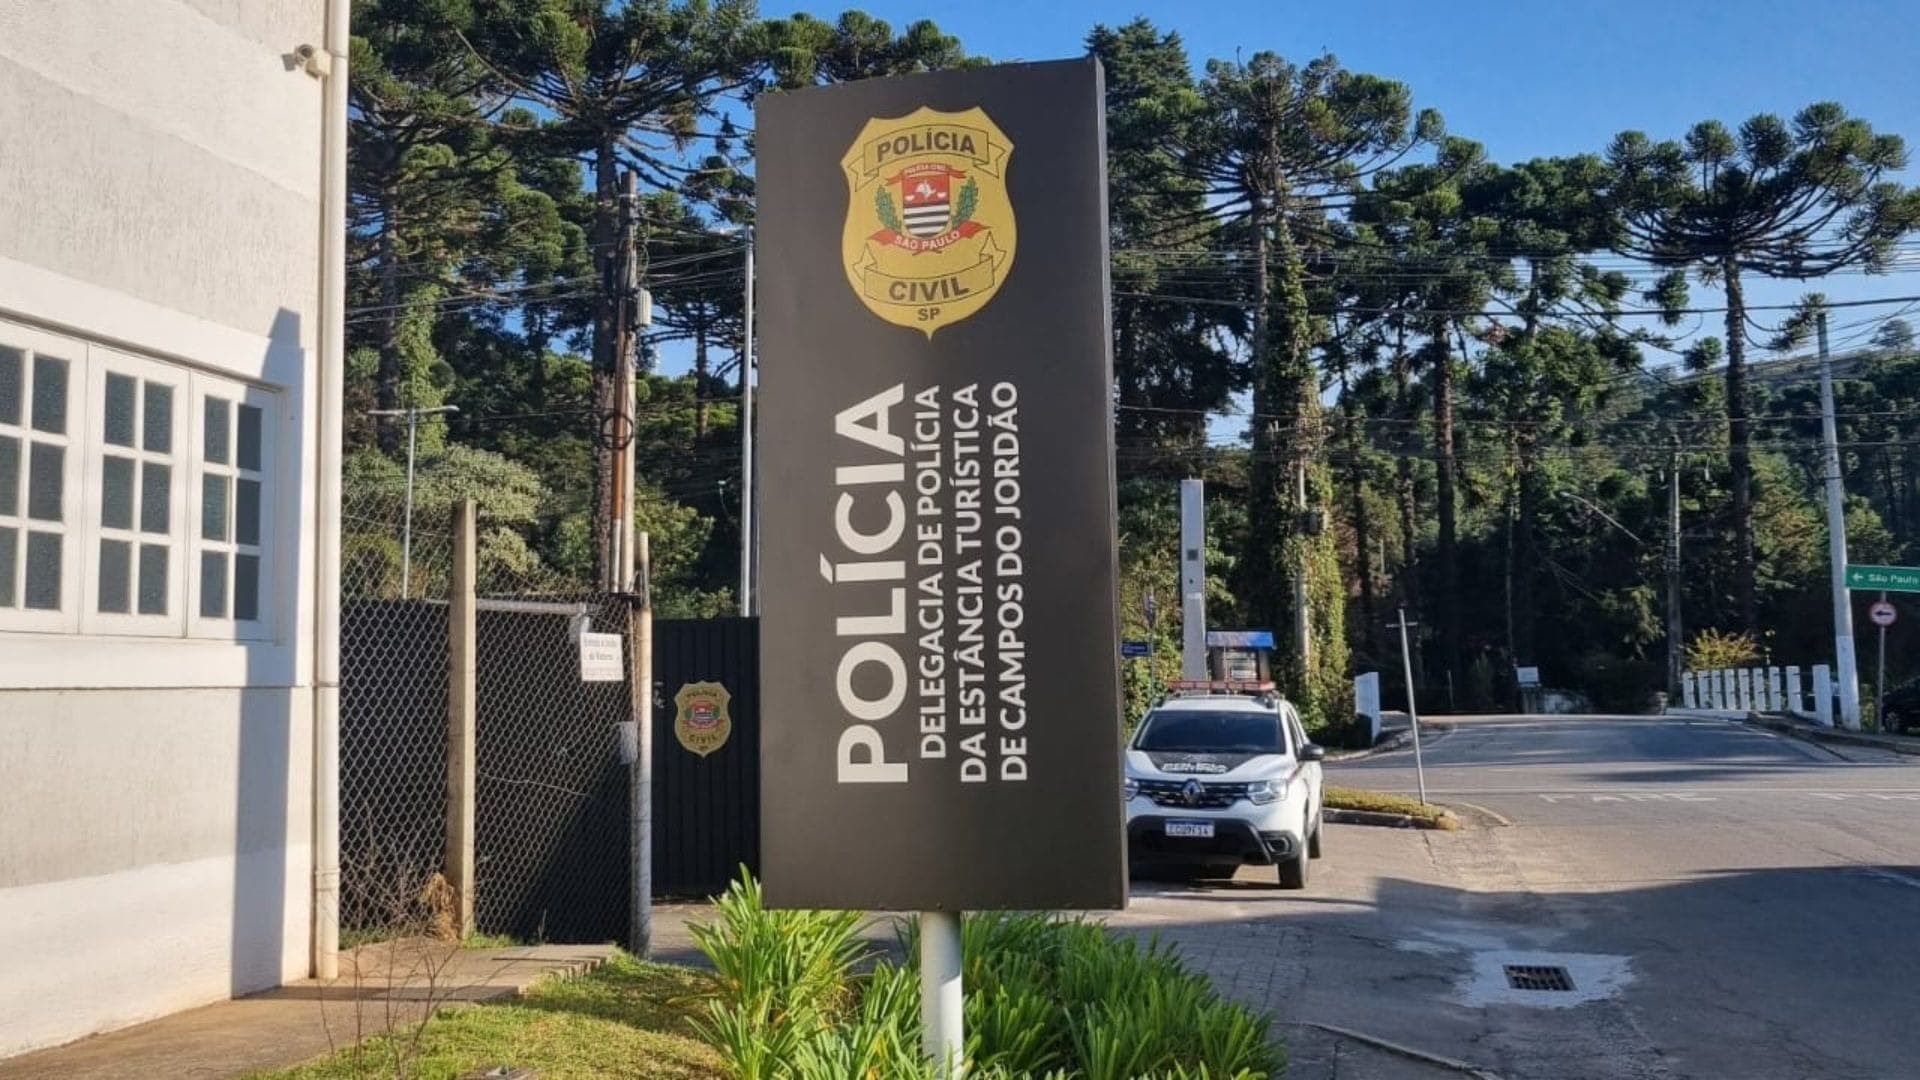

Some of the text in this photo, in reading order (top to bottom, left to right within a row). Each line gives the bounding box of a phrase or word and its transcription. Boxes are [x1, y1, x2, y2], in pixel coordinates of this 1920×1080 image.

[876, 127, 976, 163] POLÍCIA
[921, 230, 961, 250] PAULO
[888, 276, 970, 302] CIVIL
[917, 307, 941, 322] SP
[819, 382, 909, 785] POLÍCIA
[909, 385, 947, 759] DELEGACIA DE POLÍCIA
[948, 383, 987, 783] DA ESTÂNCIA TURÍSTICA
[986, 381, 1028, 781] DE CAMPOS DO JORDÃO
[1868, 573, 1919, 585] São Paulo
